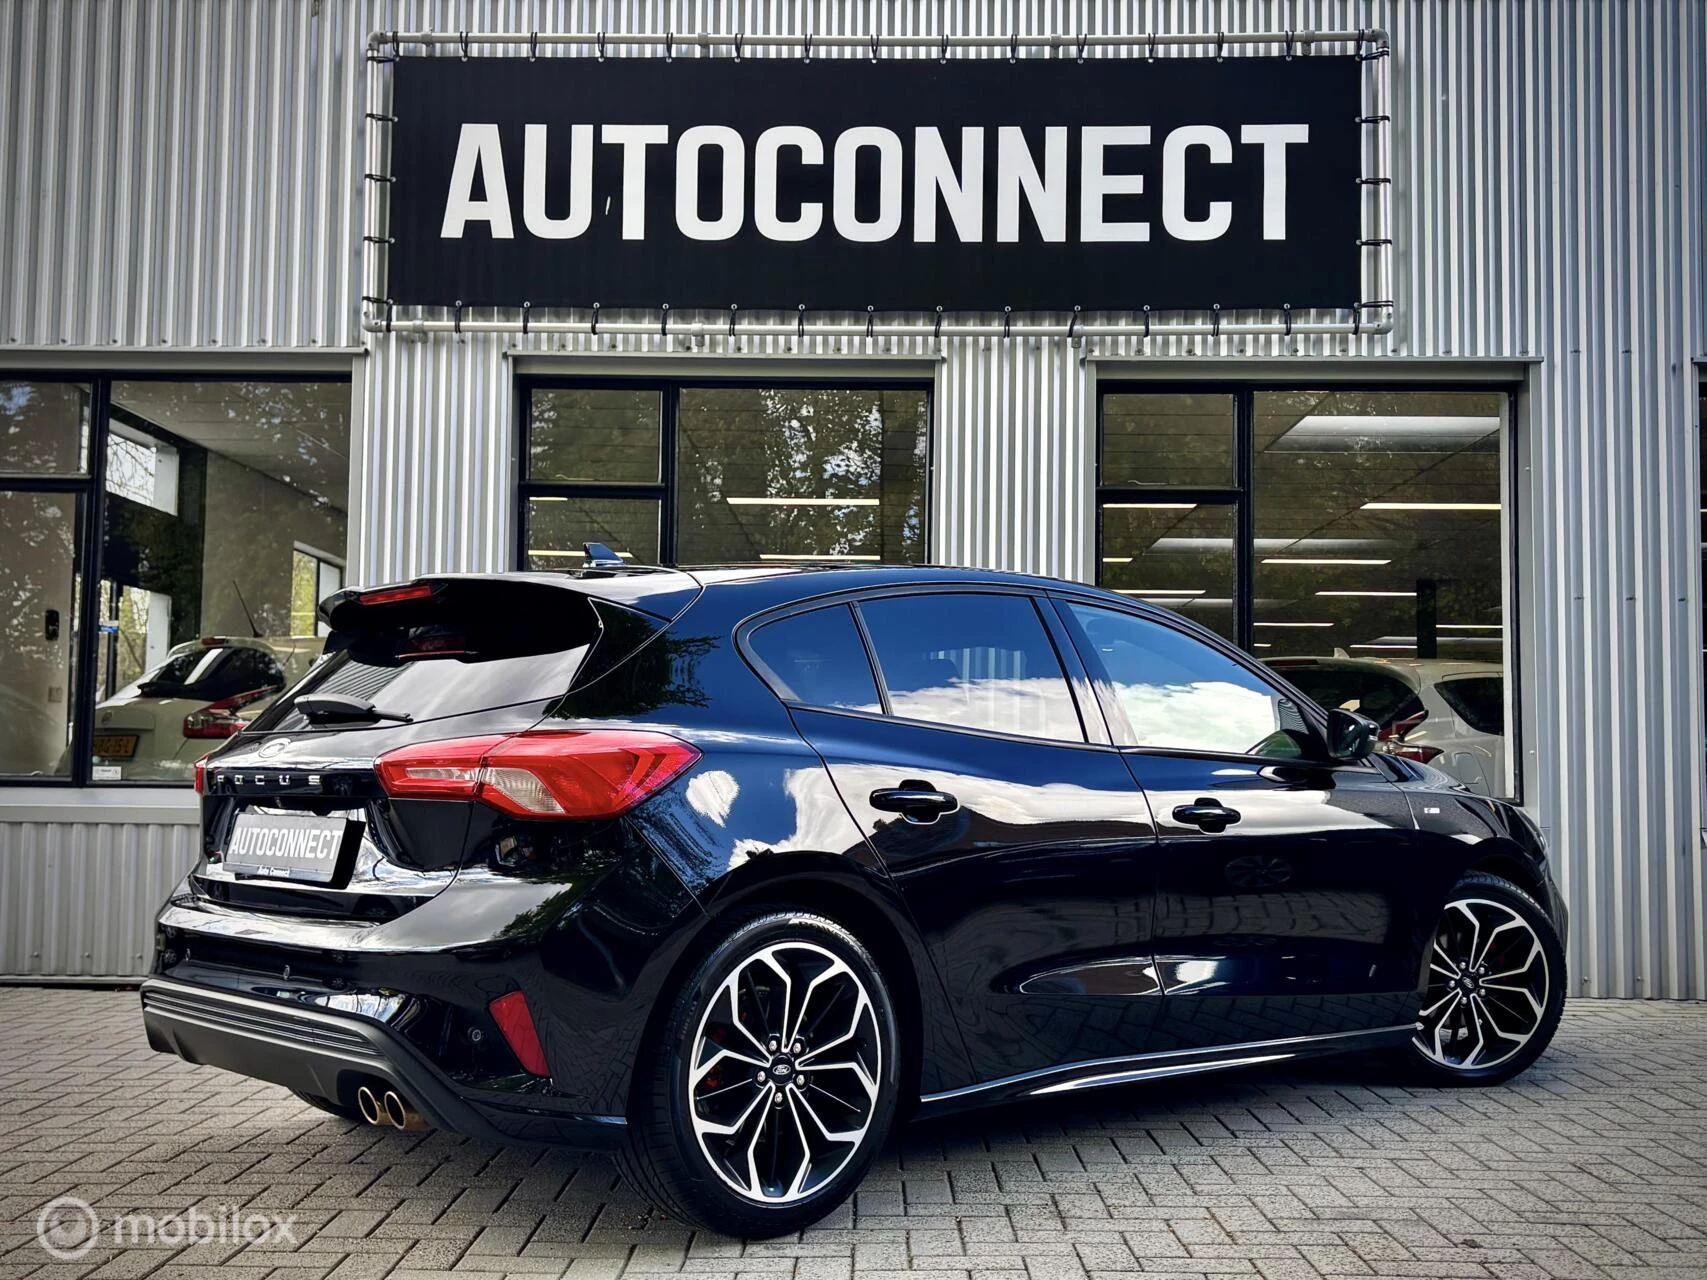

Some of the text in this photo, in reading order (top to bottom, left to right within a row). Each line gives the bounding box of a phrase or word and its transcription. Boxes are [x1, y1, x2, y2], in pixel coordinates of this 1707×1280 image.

[441, 124, 1308, 242] AUTOCONNECT
[216, 774, 321, 786] FOCUS
[228, 827, 343, 860] AUTOCONNECT
